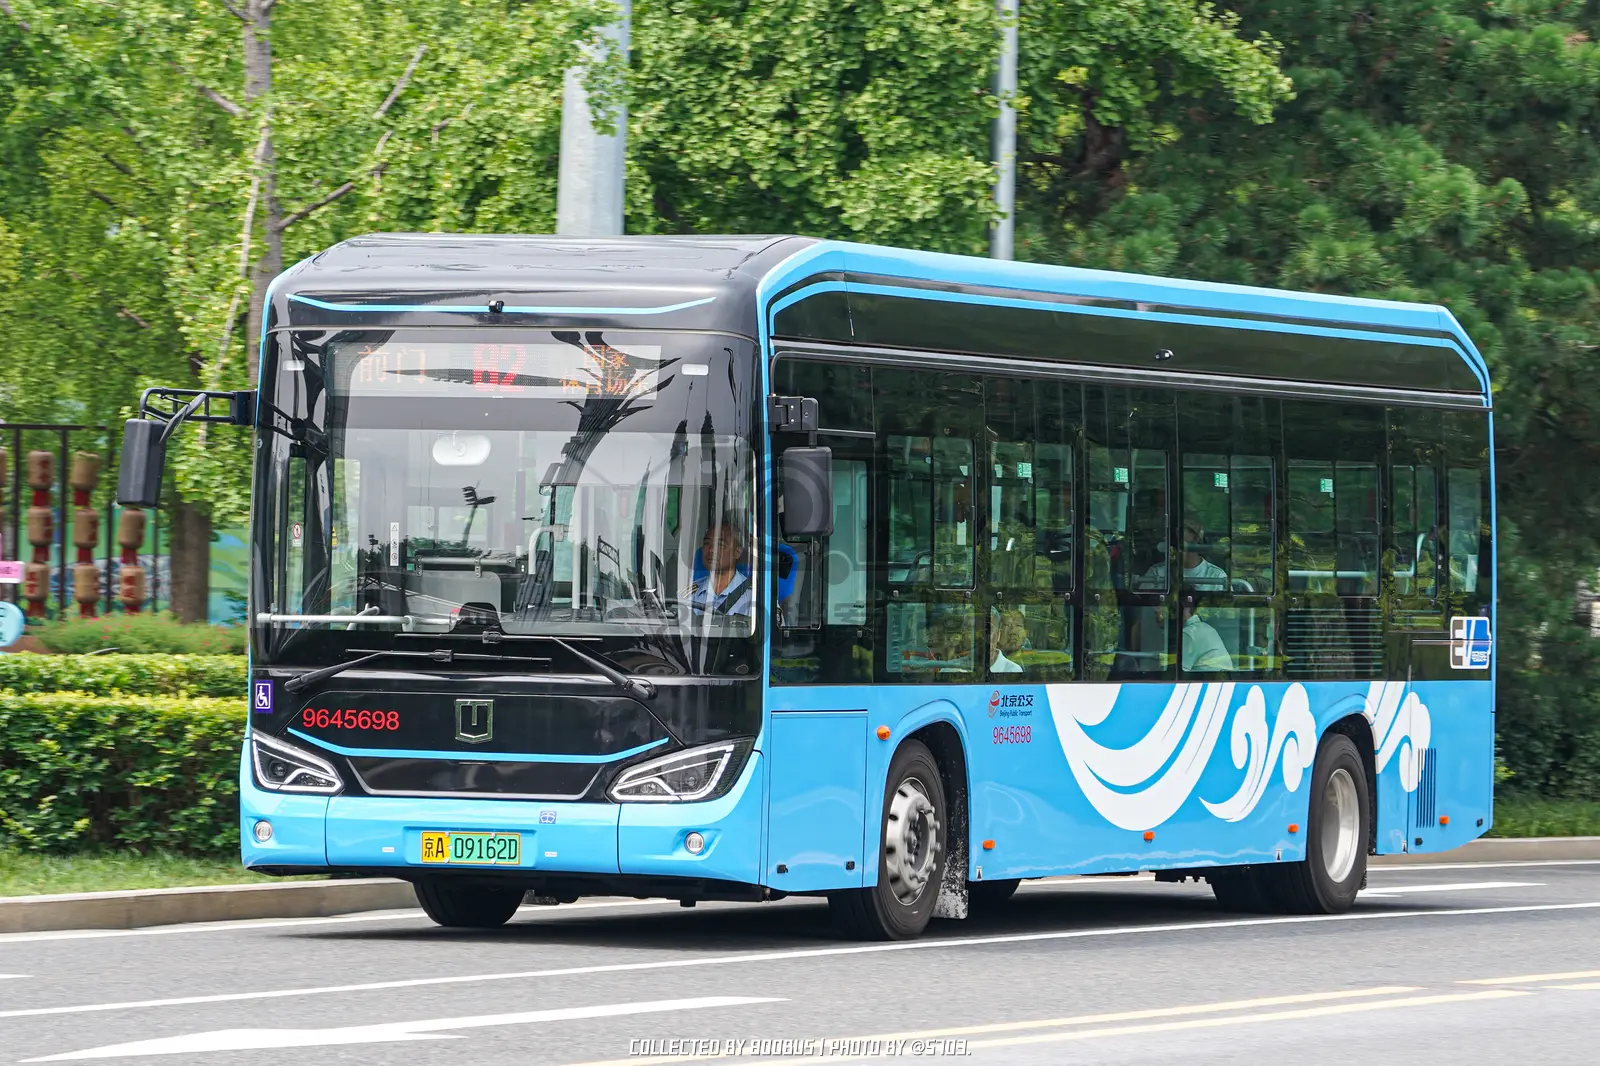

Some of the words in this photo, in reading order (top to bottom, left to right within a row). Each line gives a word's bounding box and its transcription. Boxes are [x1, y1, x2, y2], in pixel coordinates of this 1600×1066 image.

[358, 345, 427, 384] 前门
[472, 343, 527, 392] 82
[1000, 694, 1034, 708] 北京公交
[302, 708, 400, 732] 9645698
[999, 709, 1010, 719] Beijing
[1019, 709, 1033, 718] Transport
[993, 725, 1032, 745] 9645698
[454, 838, 518, 860] 09162D
